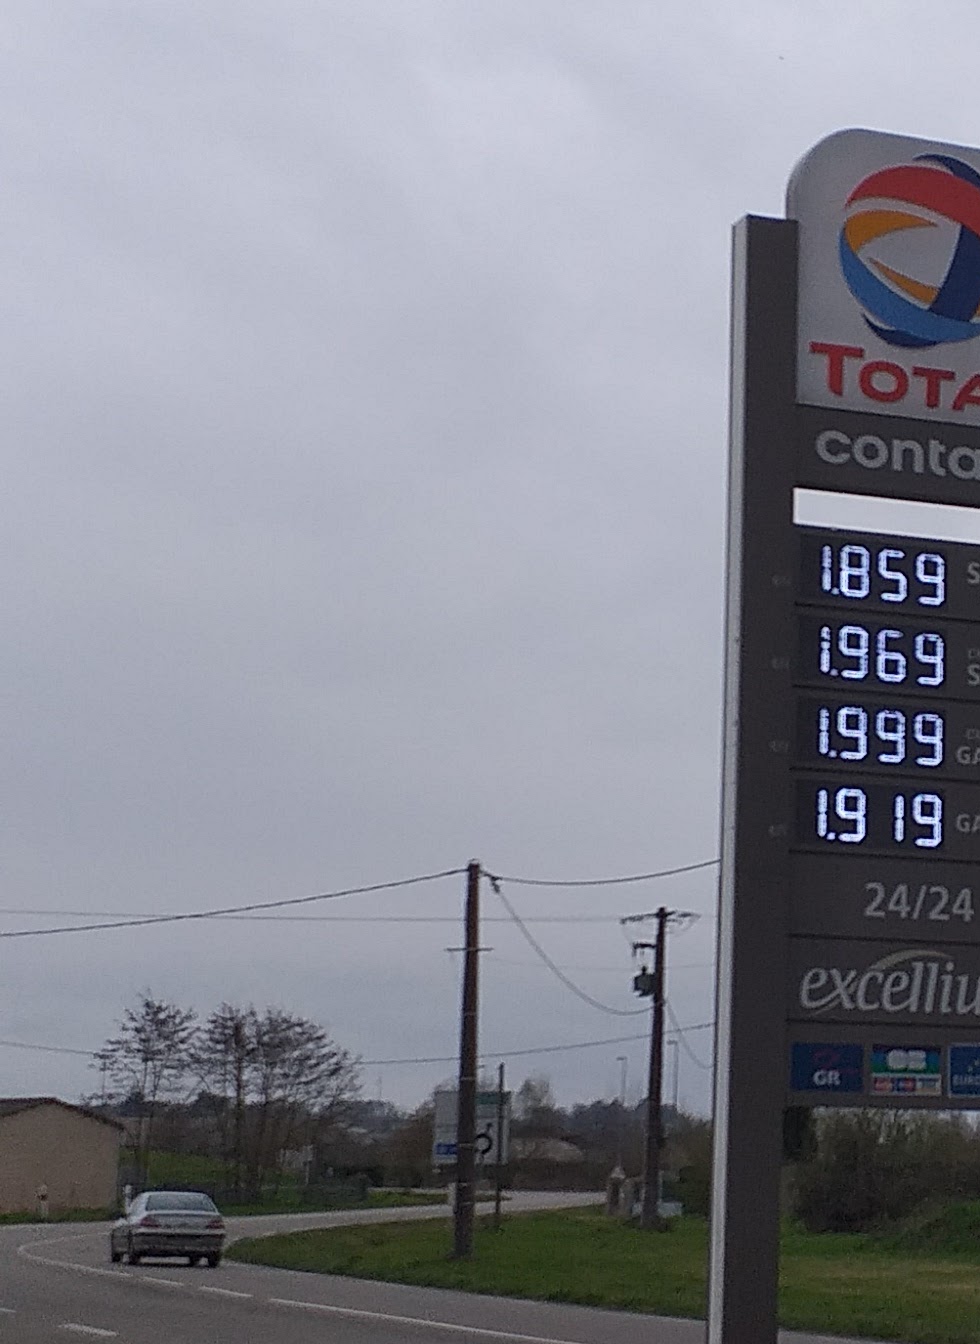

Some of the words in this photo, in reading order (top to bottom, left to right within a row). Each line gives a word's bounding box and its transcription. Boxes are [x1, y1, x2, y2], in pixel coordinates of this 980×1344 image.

[820, 544, 946, 606] 1.859
[819, 625, 945, 686] 1.969
[818, 705, 943, 767] 1.999
[816, 787, 943, 847] 1.919
[864, 882, 975, 923] 24/24
[813, 1069, 842, 1086] GR
